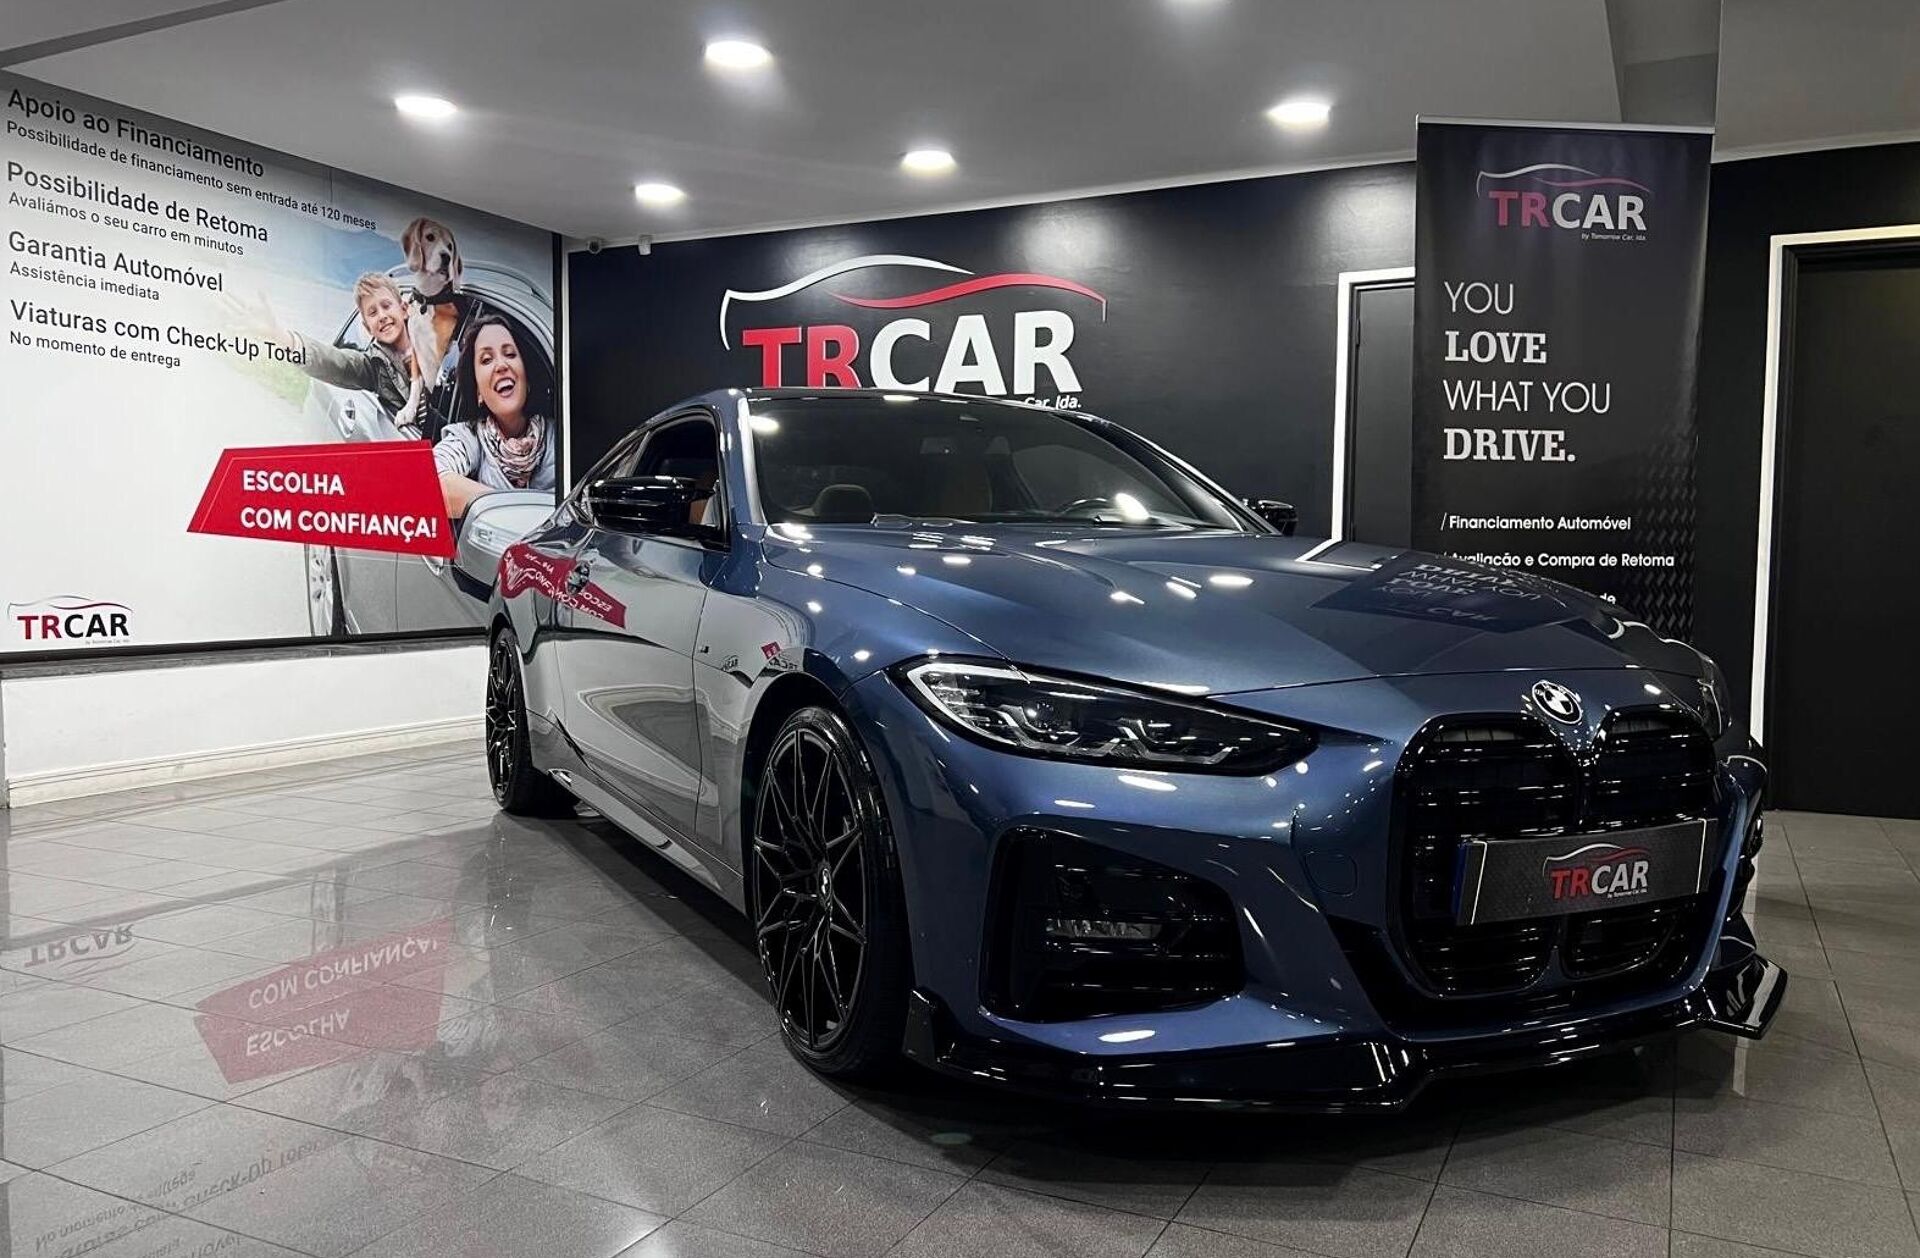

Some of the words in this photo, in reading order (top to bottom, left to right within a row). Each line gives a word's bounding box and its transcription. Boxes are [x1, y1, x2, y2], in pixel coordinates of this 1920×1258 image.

[8, 88, 75, 124] Apoio
[83, 113, 109, 134] ao
[117, 118, 264, 178] Financiamento
[7, 120, 106, 158] Possibilidade
[110, 148, 127, 163] de
[131, 153, 223, 189] financiamento
[227, 181, 252, 197] sem
[255, 190, 298, 210] entrada
[301, 201, 318, 215] até
[321, 206, 340, 221] 120
[342, 214, 377, 230] meses
[8, 161, 159, 216] Possibilidade
[166, 200, 190, 223] de
[196, 207, 268, 242] Retoma
[1488, 190, 1647, 231] TRCAR
[9, 191, 86, 220] Avaliámos
[91, 213, 100, 223] o
[104, 215, 129, 230] seu
[132, 222, 167, 239] carro
[170, 231, 190, 244] em
[194, 235, 244, 256] minutos
[9, 231, 106, 269] Garantia
[114, 253, 222, 292] Automóvel
[10, 261, 96, 289] Assistência
[100, 278, 160, 300] imediata
[1443, 281, 1514, 315] YOU
[10, 299, 107, 334] Viaturas
[114, 320, 160, 342] com
[167, 326, 260, 361] Check-Up
[264, 341, 306, 365] Total
[10, 331, 32, 346] No
[36, 336, 106, 357] momento
[110, 346, 127, 359] de
[131, 351, 181, 369] entrega
[1444, 330, 1547, 364] LOVE
[741, 310, 1083, 396] TRCAR
[1442, 379, 1534, 412] WHAT
[1542, 381, 1611, 414] YOU
[1442, 427, 1577, 463] DRIVE.
[242, 469, 345, 496] ESCOLHA
[240, 507, 292, 531] COM
[297, 511, 437, 544] CONFIANÇA!
[1557, 515, 1632, 531] Automóvel
[1524, 555, 1535, 568] e
[1538, 552, 1595, 569] Compra
[1599, 552, 1619, 568] de
[1621, 552, 1675, 568] Retoma
[17, 613, 130, 640] TRCAR
[1551, 861, 1649, 899] TRCAR
